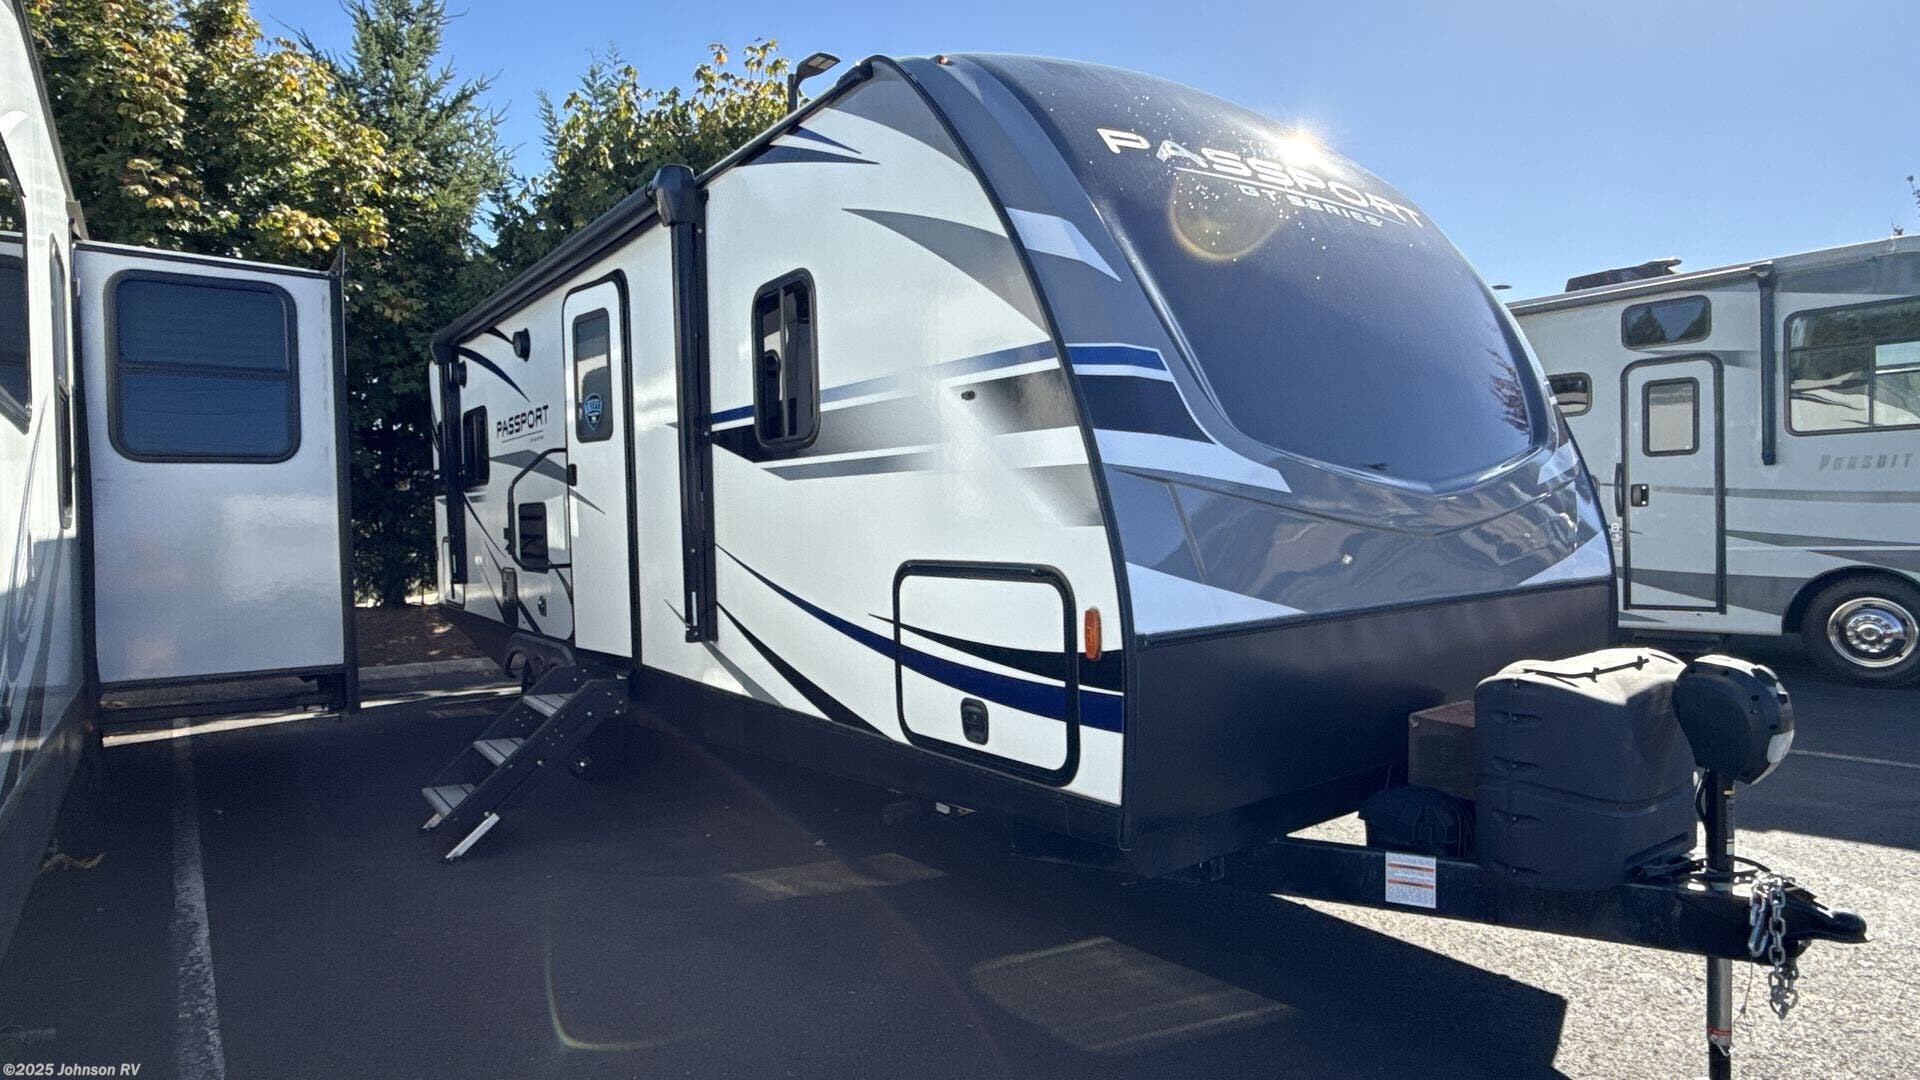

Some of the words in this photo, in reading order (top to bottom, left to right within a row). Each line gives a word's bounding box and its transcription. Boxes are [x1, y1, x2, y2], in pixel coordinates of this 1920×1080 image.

[1097, 128, 1424, 228] PASSPORT
[1239, 184, 1276, 202] GT
[1290, 196, 1384, 227] SERIES
[496, 404, 549, 438] PASSPORT
